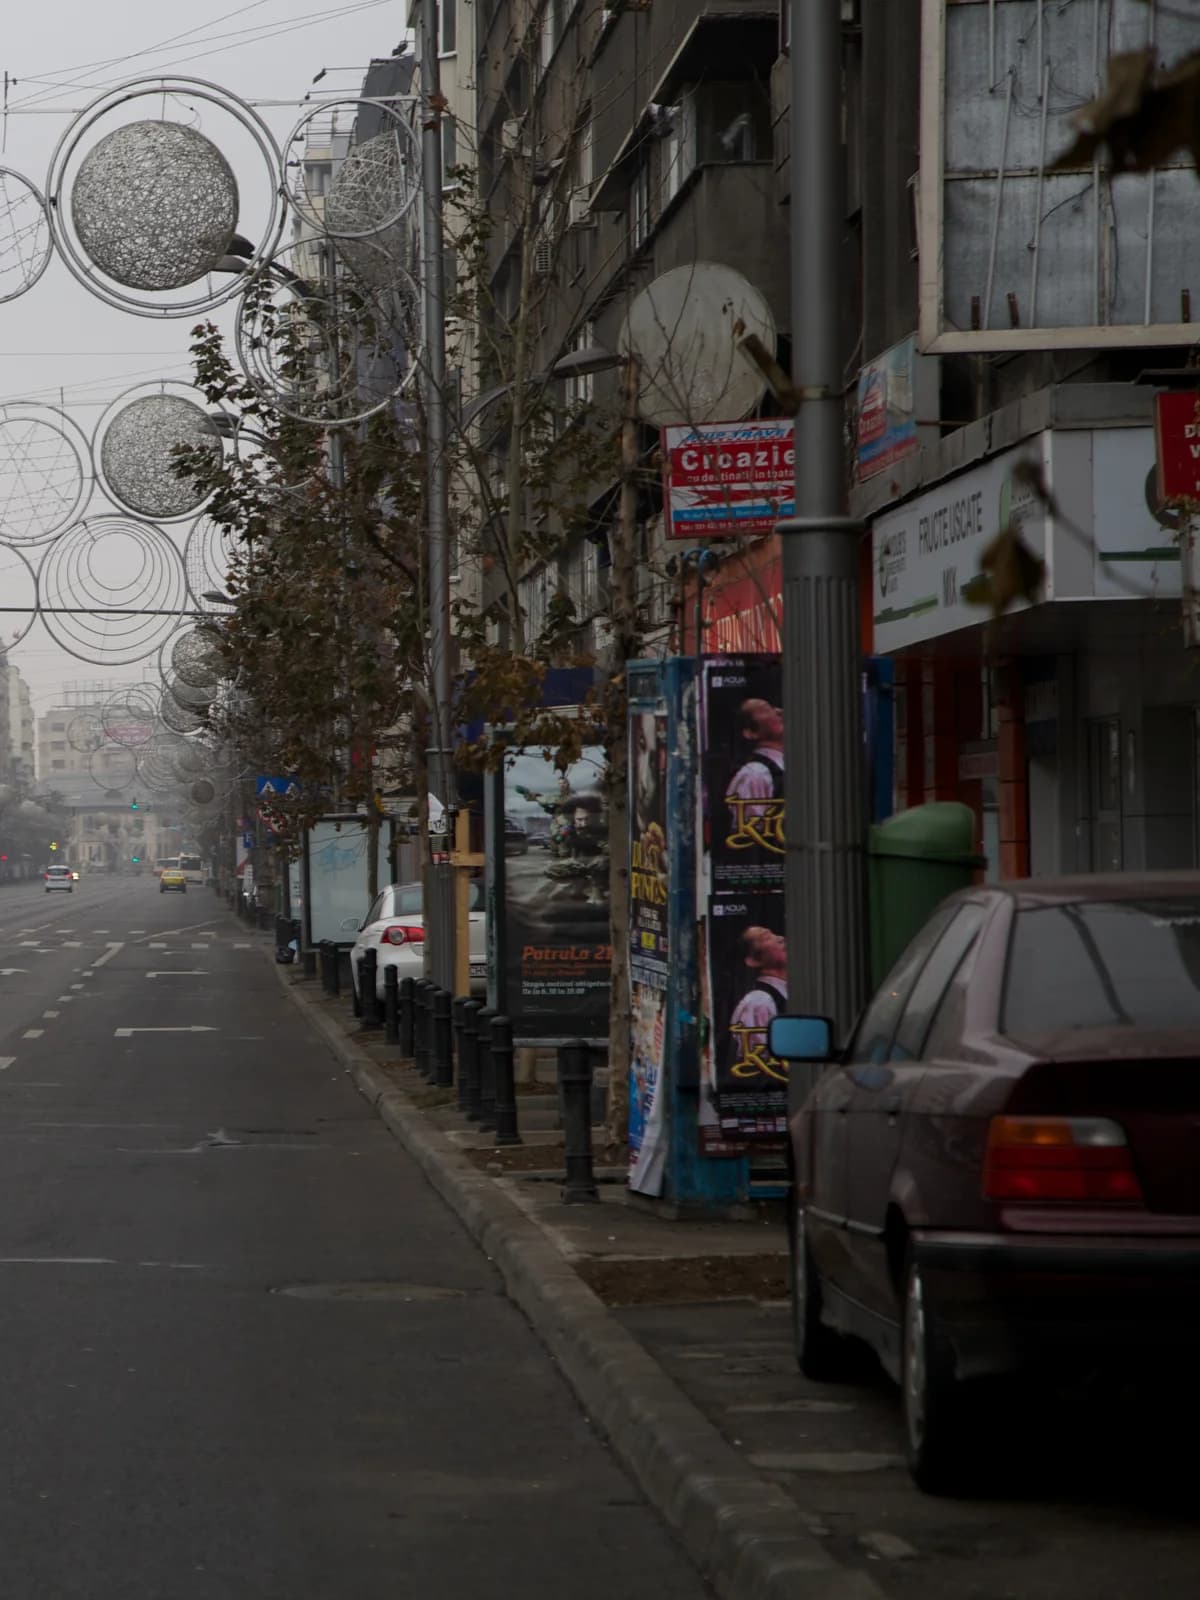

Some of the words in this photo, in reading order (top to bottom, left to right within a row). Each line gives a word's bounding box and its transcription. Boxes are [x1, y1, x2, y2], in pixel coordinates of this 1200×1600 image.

[919, 507, 948, 556] FRUCTE
[951, 491, 983, 543] USCATE
[942, 566, 958, 608] MIX
